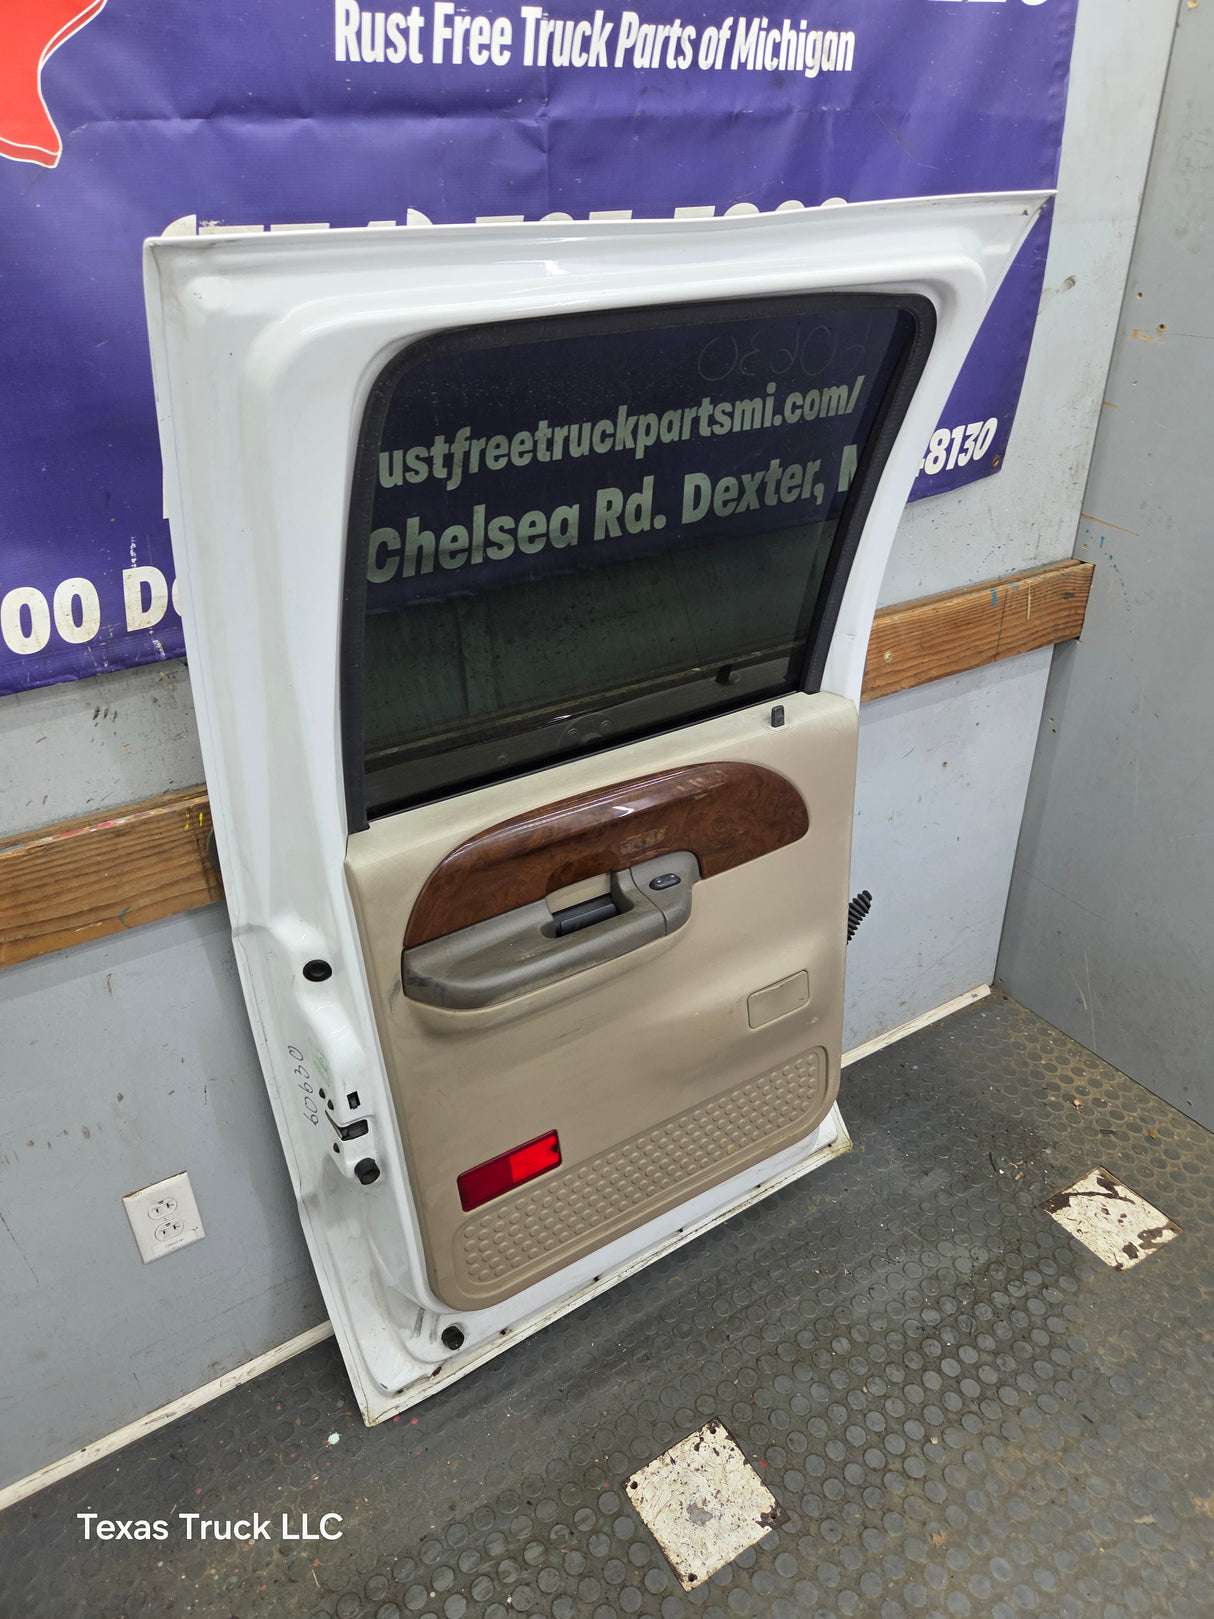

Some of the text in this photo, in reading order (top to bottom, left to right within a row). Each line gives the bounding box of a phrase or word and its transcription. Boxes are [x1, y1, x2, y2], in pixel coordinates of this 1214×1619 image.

[335, 0, 855, 78] Rust Free Truck Parts of Michigan
[365, 503, 580, 584] Chelsea
[593, 475, 667, 541] Rd.
[680, 456, 824, 524] Dexter,
[915, 417, 999, 478] 8130
